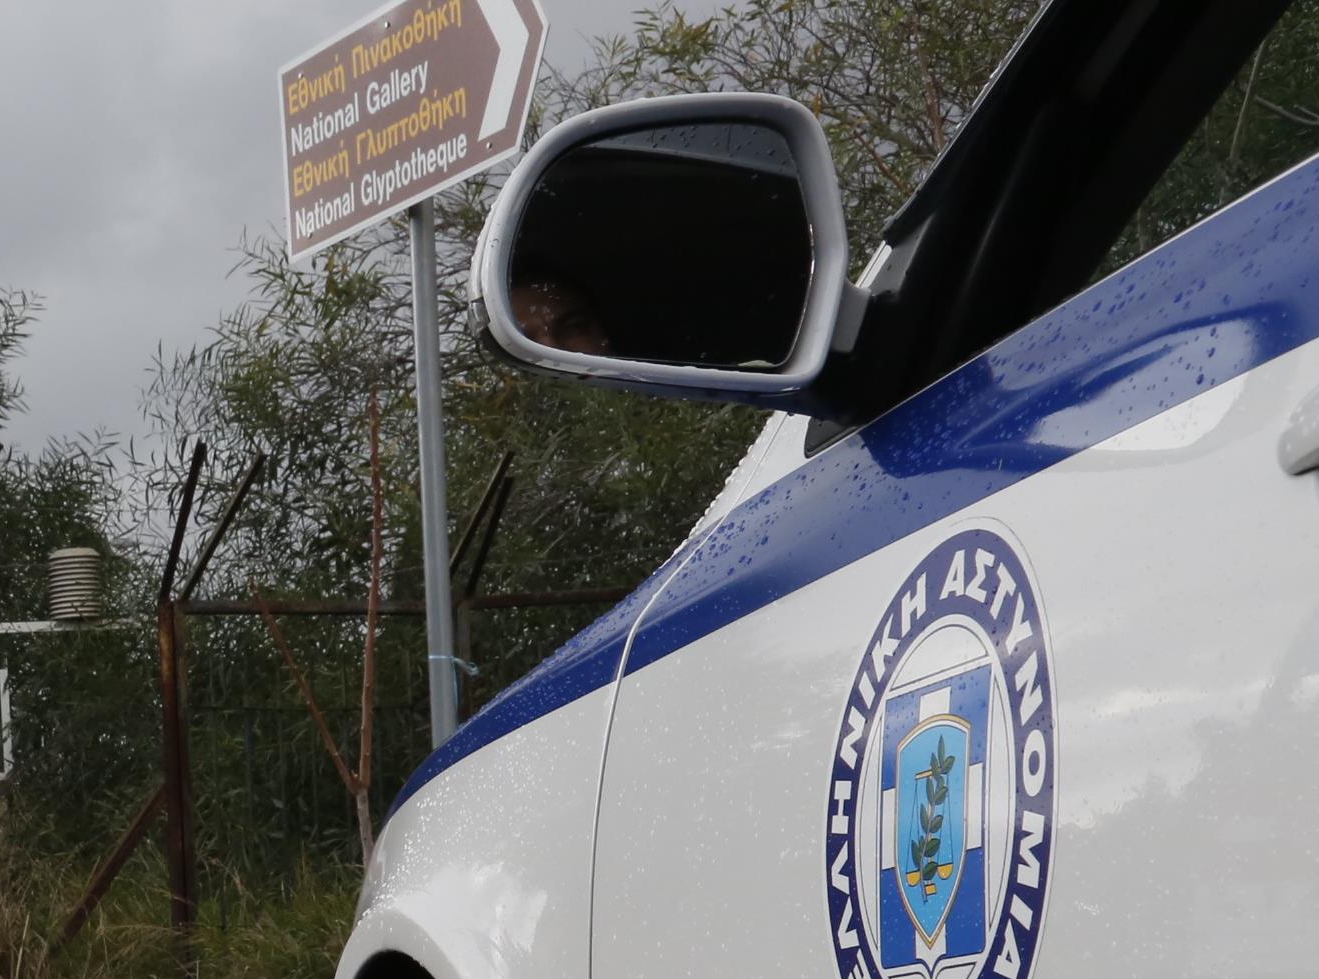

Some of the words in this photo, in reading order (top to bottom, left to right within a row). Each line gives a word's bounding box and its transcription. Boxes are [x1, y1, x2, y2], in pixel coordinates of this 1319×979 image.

[288, 54, 345, 115] Εθνική
[351, 0, 463, 79] Πινακοθήκη
[291, 93, 360, 156] National
[366, 60, 429, 115] Gallery
[293, 139, 350, 197] Εθνική
[356, 87, 467, 164] Γλυπτοθήκη
[295, 183, 355, 240] National
[360, 133, 468, 206] Glyptotheque
